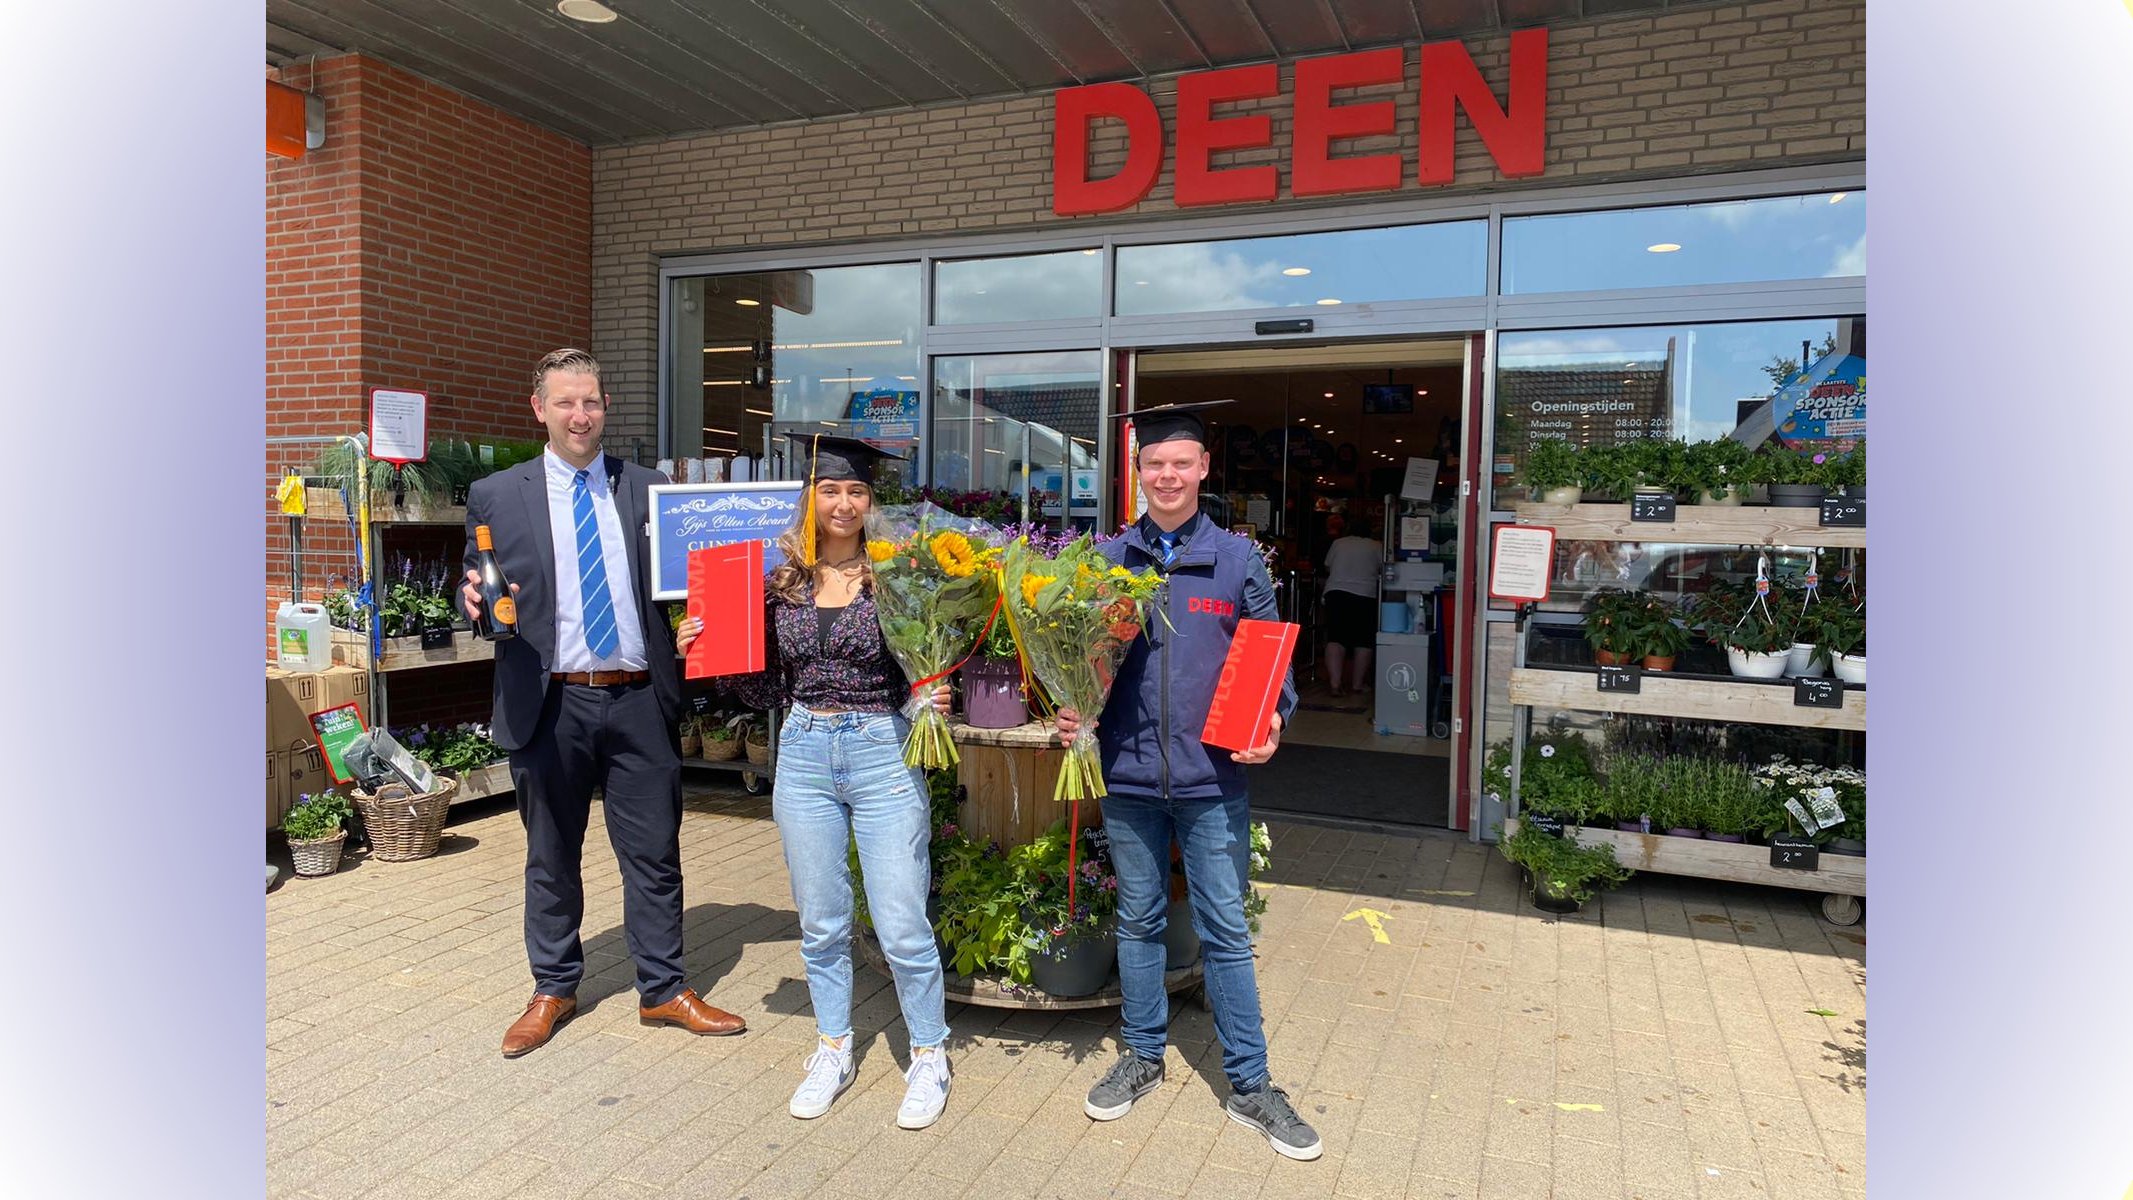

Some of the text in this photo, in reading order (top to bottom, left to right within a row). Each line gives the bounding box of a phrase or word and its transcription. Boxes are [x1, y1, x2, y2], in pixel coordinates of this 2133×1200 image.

[1053, 27, 1549, 217] DEEN
[1531, 400, 1635, 415] Openingstijden
[1795, 394, 1866, 410] SPONSOR
[863, 406, 905, 417] SPONSOR
[1808, 406, 1856, 421] ACTIE
[871, 415, 898, 425] ACTIE
[1530, 420, 1572, 430] Maandag
[1615, 418, 1642, 427] 08:00
[1650, 418, 1675, 427] 20:00
[1530, 431, 1567, 440] Dinsdag
[1614, 430, 1642, 438] 08:00
[1647, 506, 1655, 516] 2
[1835, 508, 1843, 518] 2
[676, 515, 707, 536] Gijs
[747, 513, 793, 527] Award
[1188, 597, 1234, 617] DEEN
[685, 550, 705, 678] DIOMA
[1808, 692, 1816, 702] 4
[1098, 849, 1106, 862] 5
[1782, 851, 1790, 862] 2
